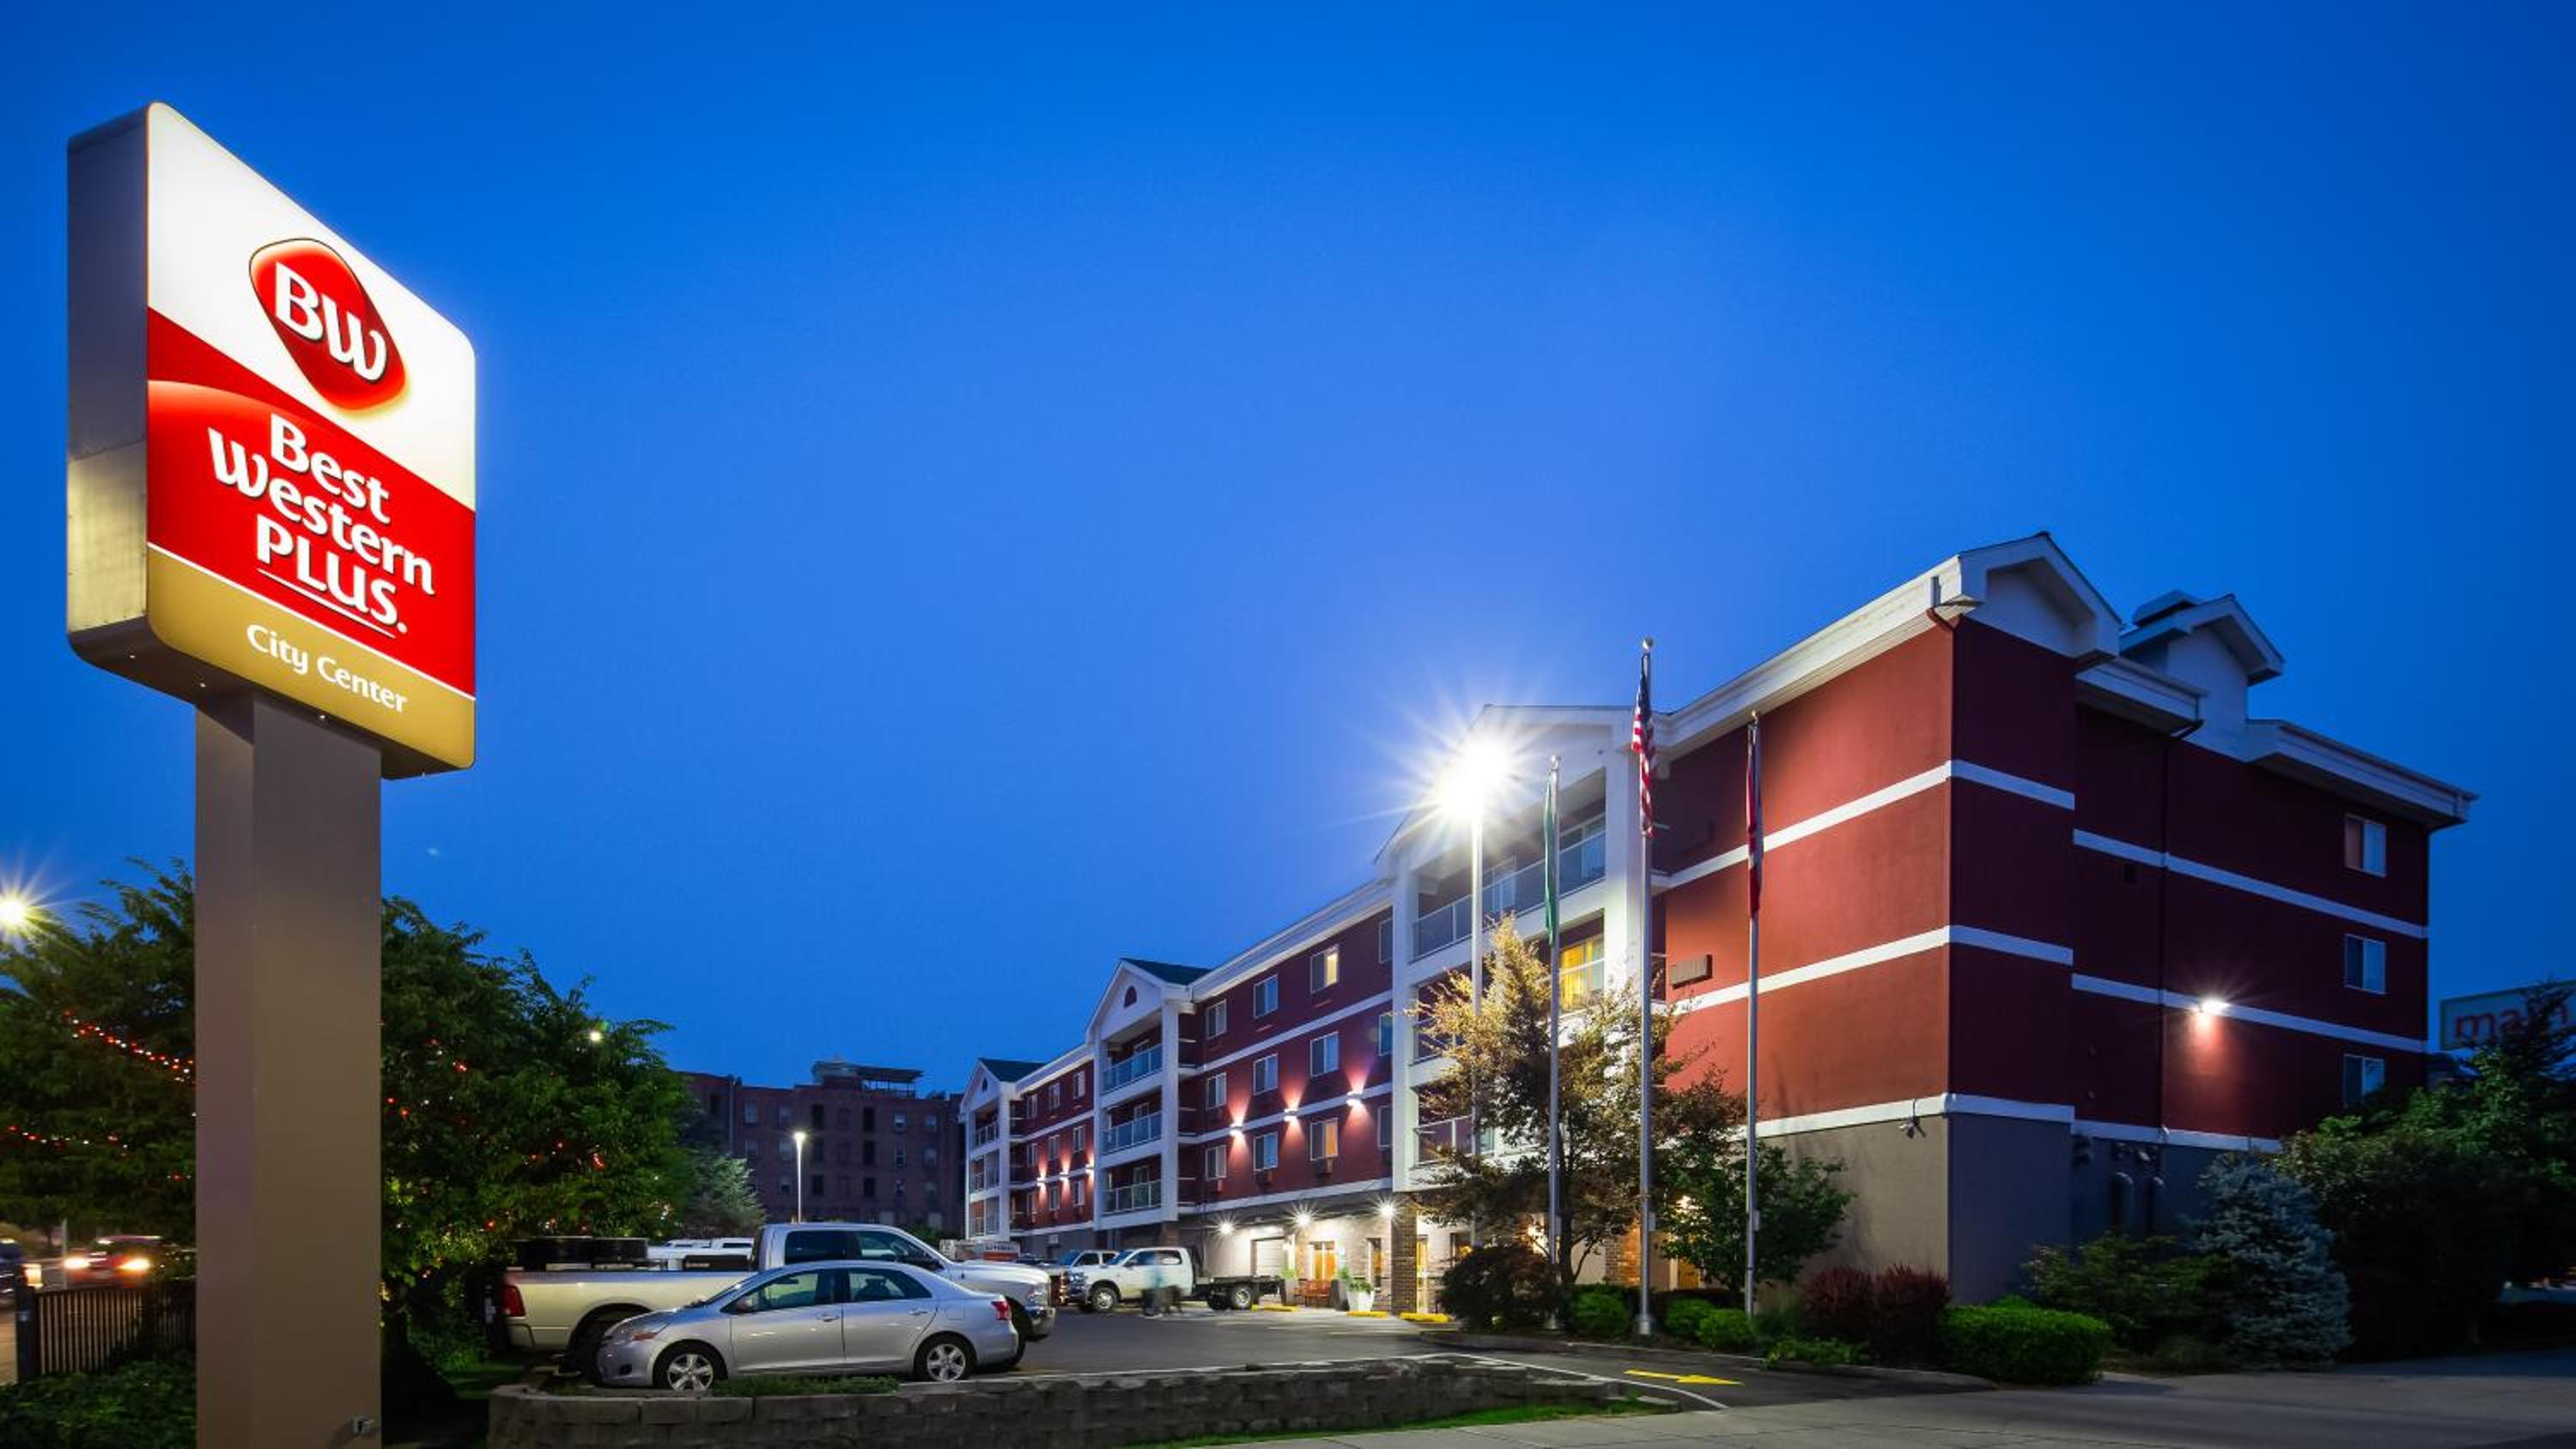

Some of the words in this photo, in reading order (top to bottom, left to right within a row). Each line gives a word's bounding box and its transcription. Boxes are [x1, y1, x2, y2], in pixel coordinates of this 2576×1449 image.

[275, 262, 386, 381] BW
[207, 427, 435, 595] Western
[270, 413, 390, 524] Best
[246, 624, 309, 676] City
[317, 656, 408, 713] Center
